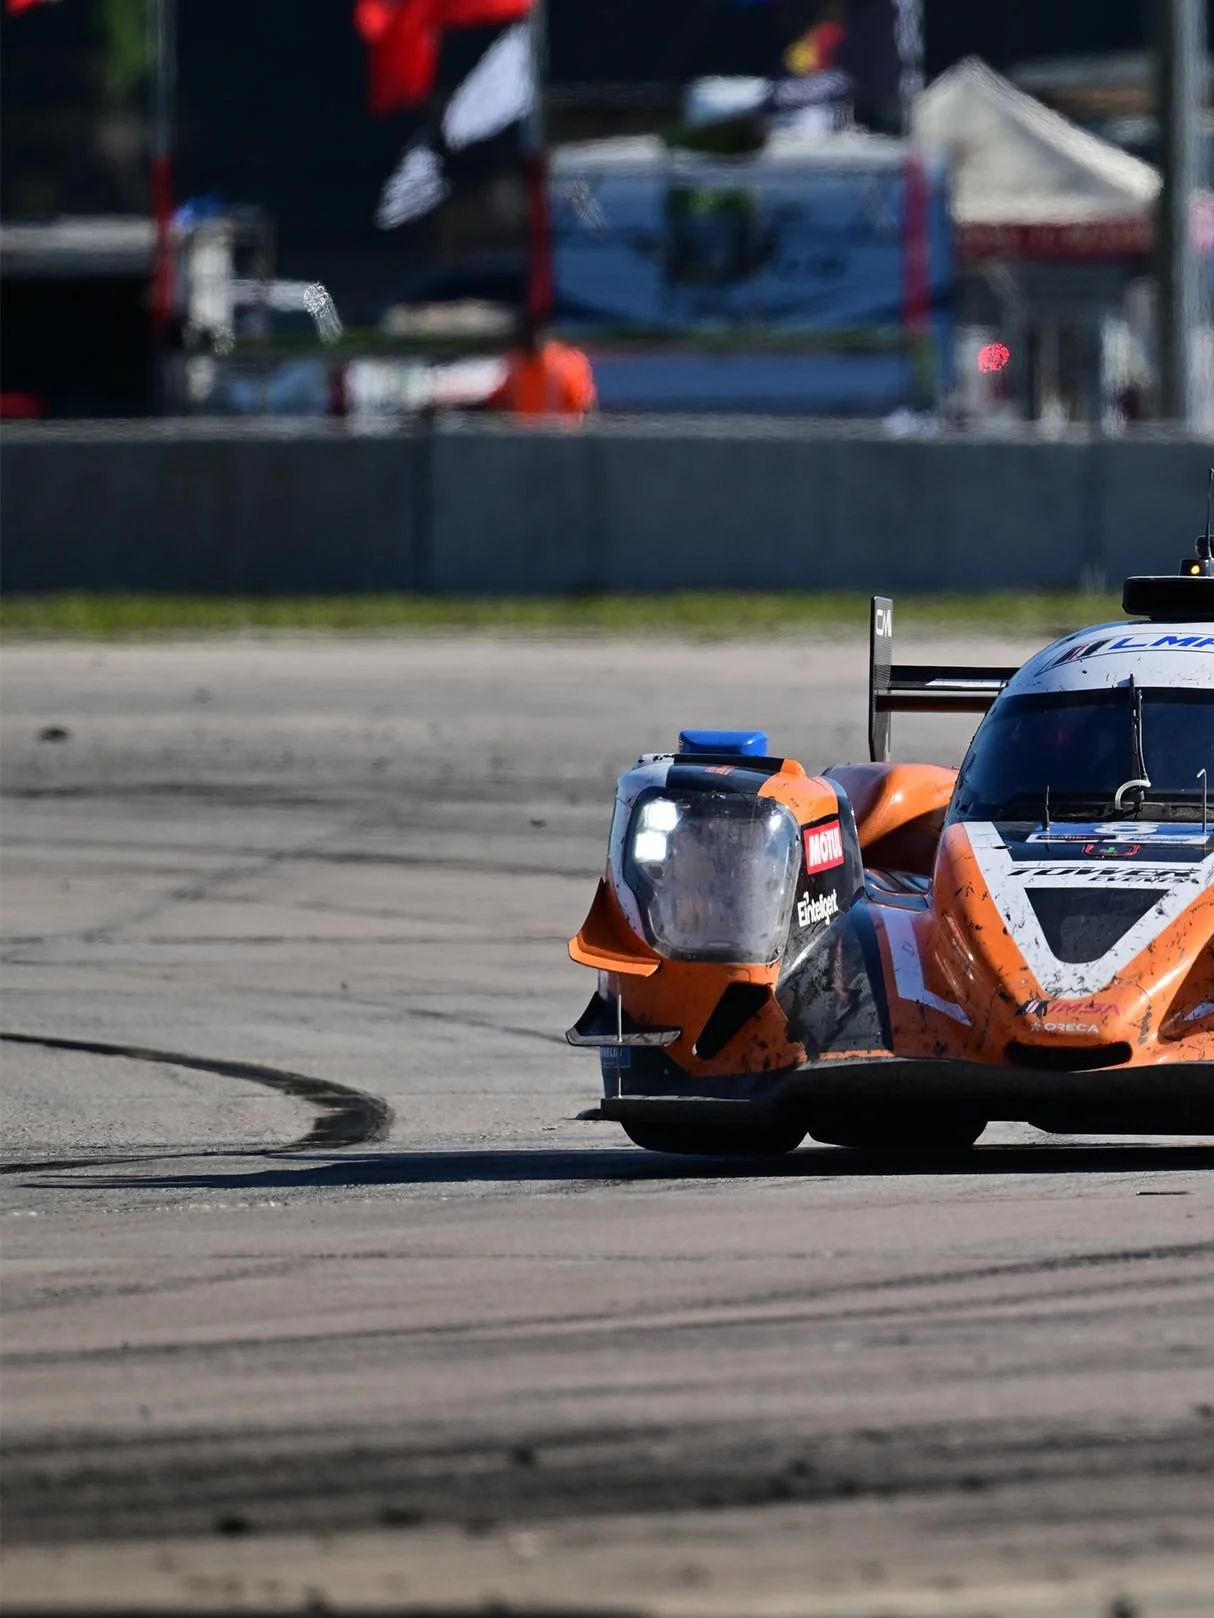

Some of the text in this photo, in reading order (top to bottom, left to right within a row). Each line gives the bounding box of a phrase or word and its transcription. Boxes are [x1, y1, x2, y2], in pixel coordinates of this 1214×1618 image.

[1093, 822, 1160, 834] 8
[809, 827, 843, 867] MOTUL
[1047, 1002, 1121, 1016] IMSA
[1044, 1022, 1100, 1033] ORECA
